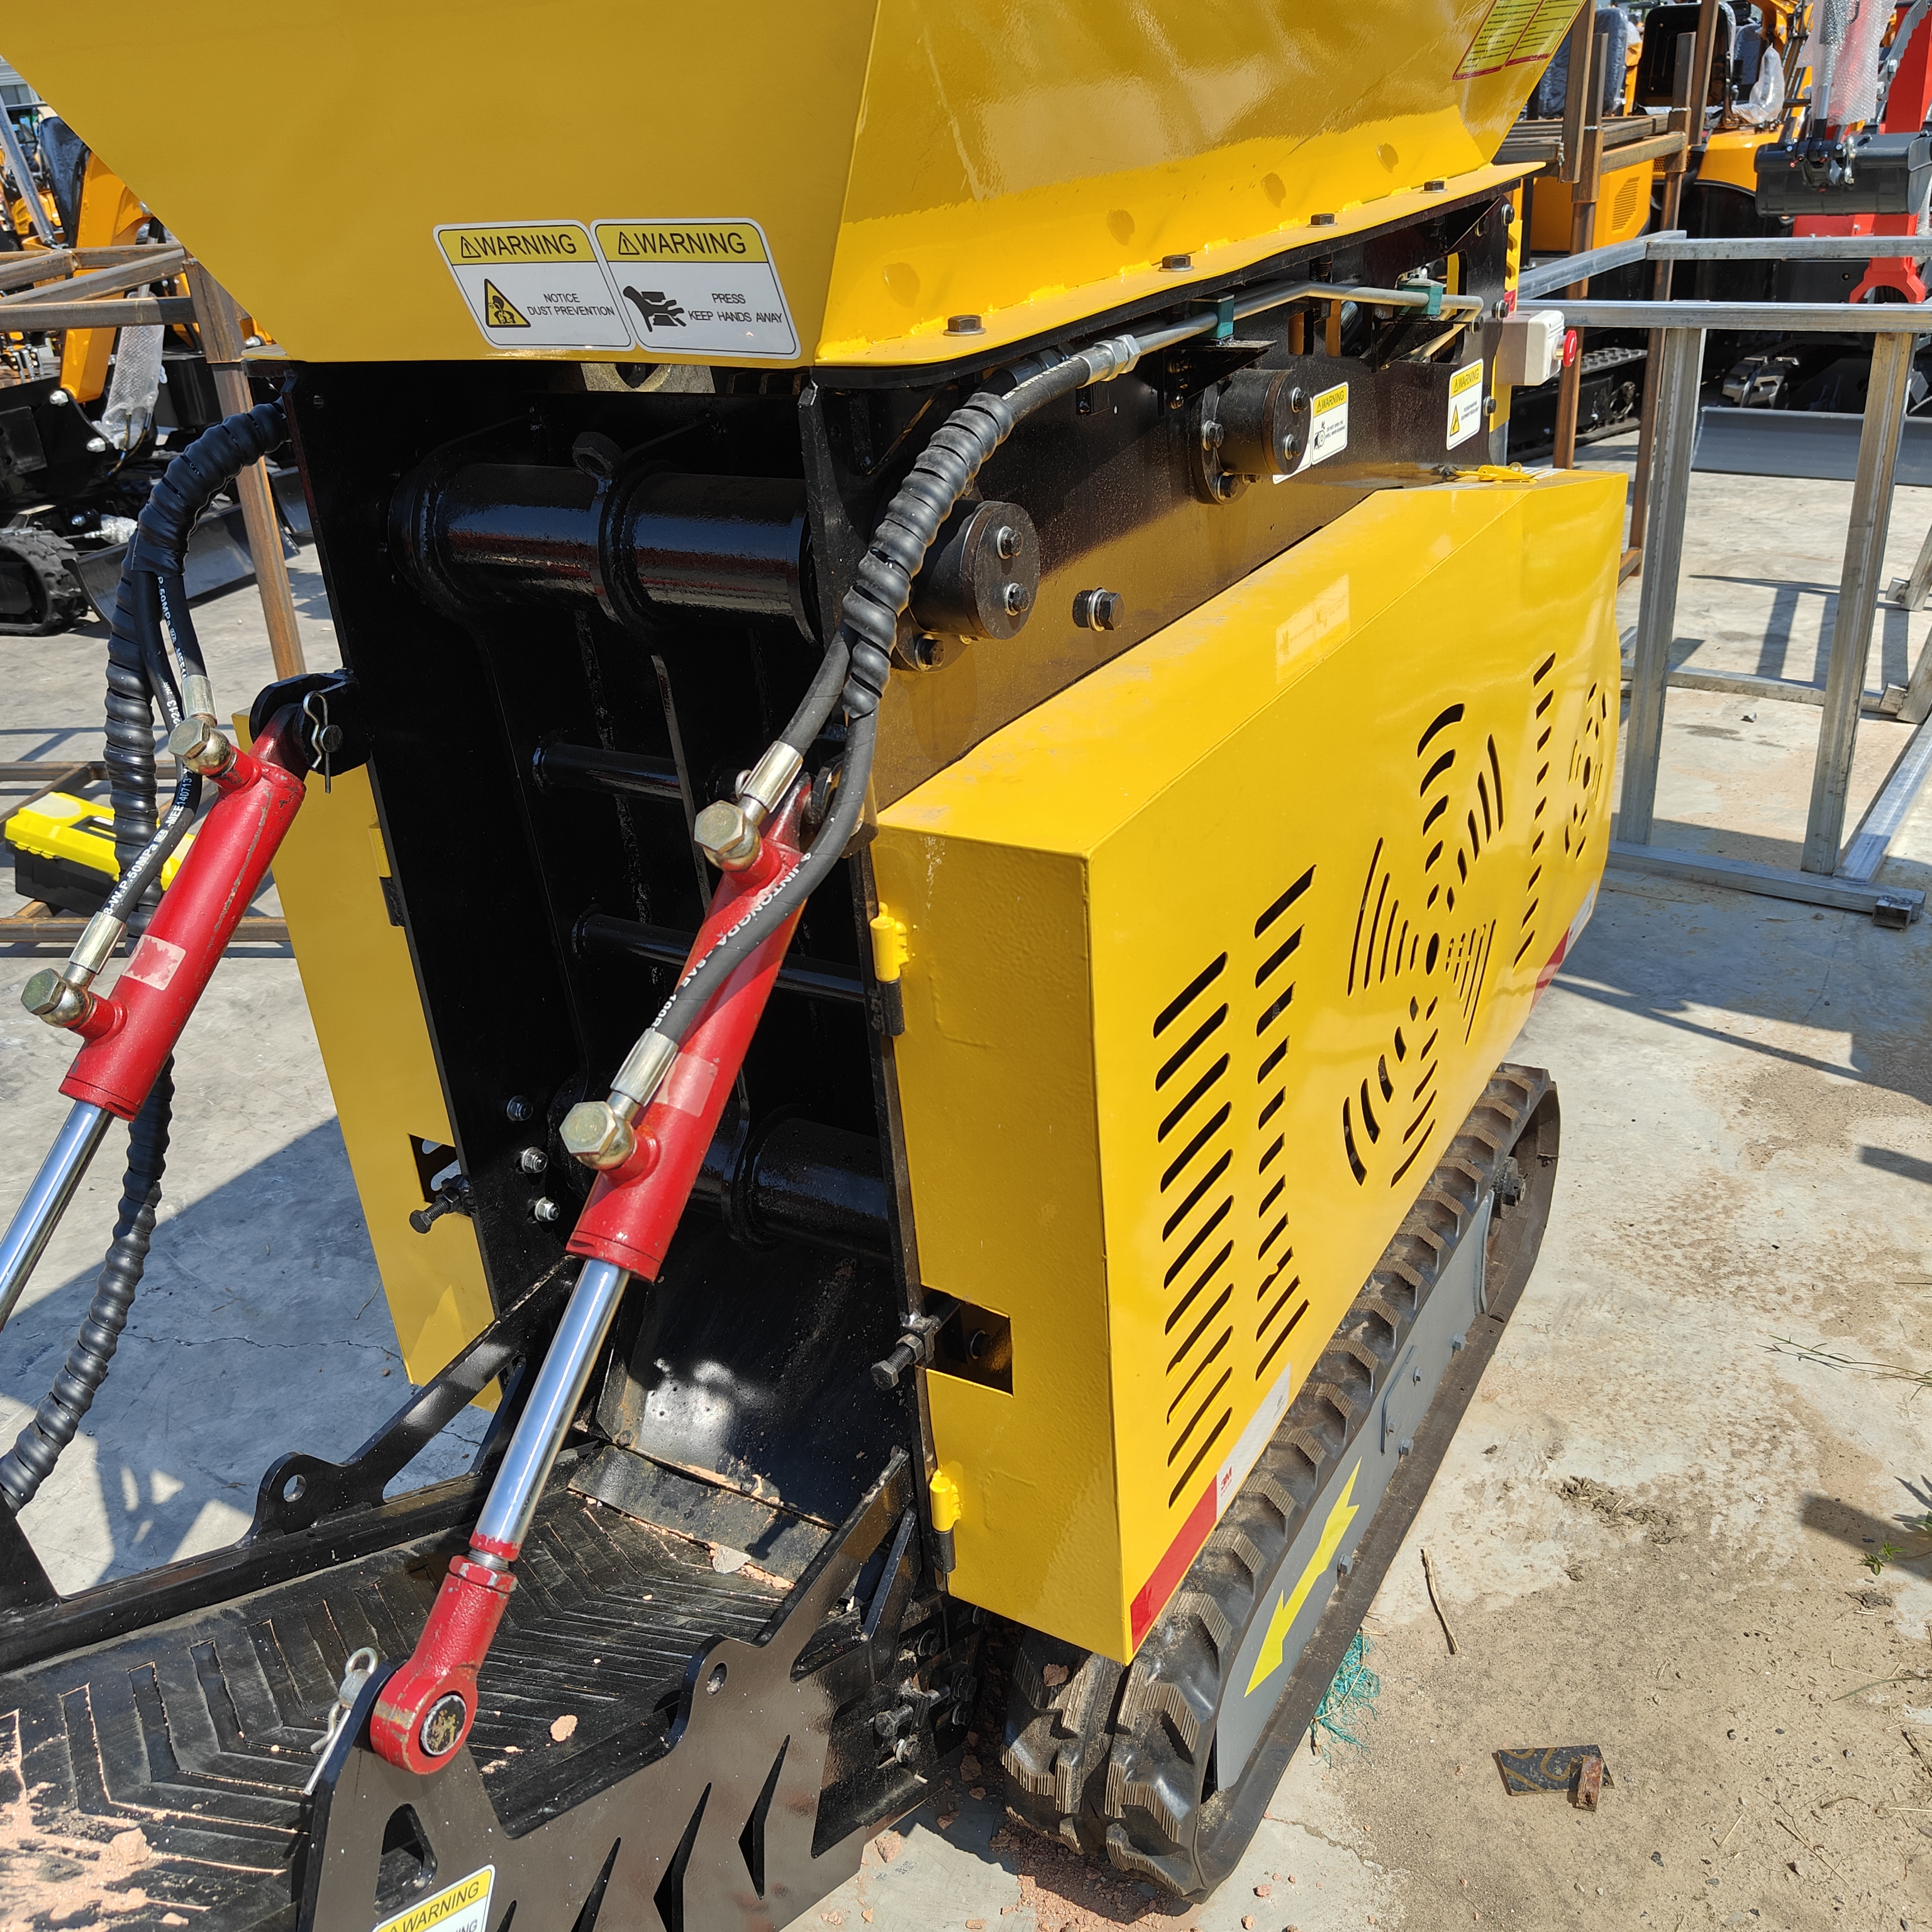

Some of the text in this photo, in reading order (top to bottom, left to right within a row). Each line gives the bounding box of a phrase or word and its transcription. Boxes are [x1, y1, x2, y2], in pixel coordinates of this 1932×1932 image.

[474, 234, 577, 257] WARNING
[633, 232, 747, 254] WARNING
[543, 293, 580, 303] NOTICE
[711, 293, 746, 304] PRESS
[527, 306, 615, 316] DUST PREVENTION
[688, 310, 782, 323] KEEP HANDS AWAY
[1458, 368, 1479, 390] WARNING
[1321, 390, 1345, 409] WARNING
[650, 993, 677, 1032] 100R
[1221, 1466, 1232, 1491] 3M
[403, 1881, 479, 1932] WARNING
